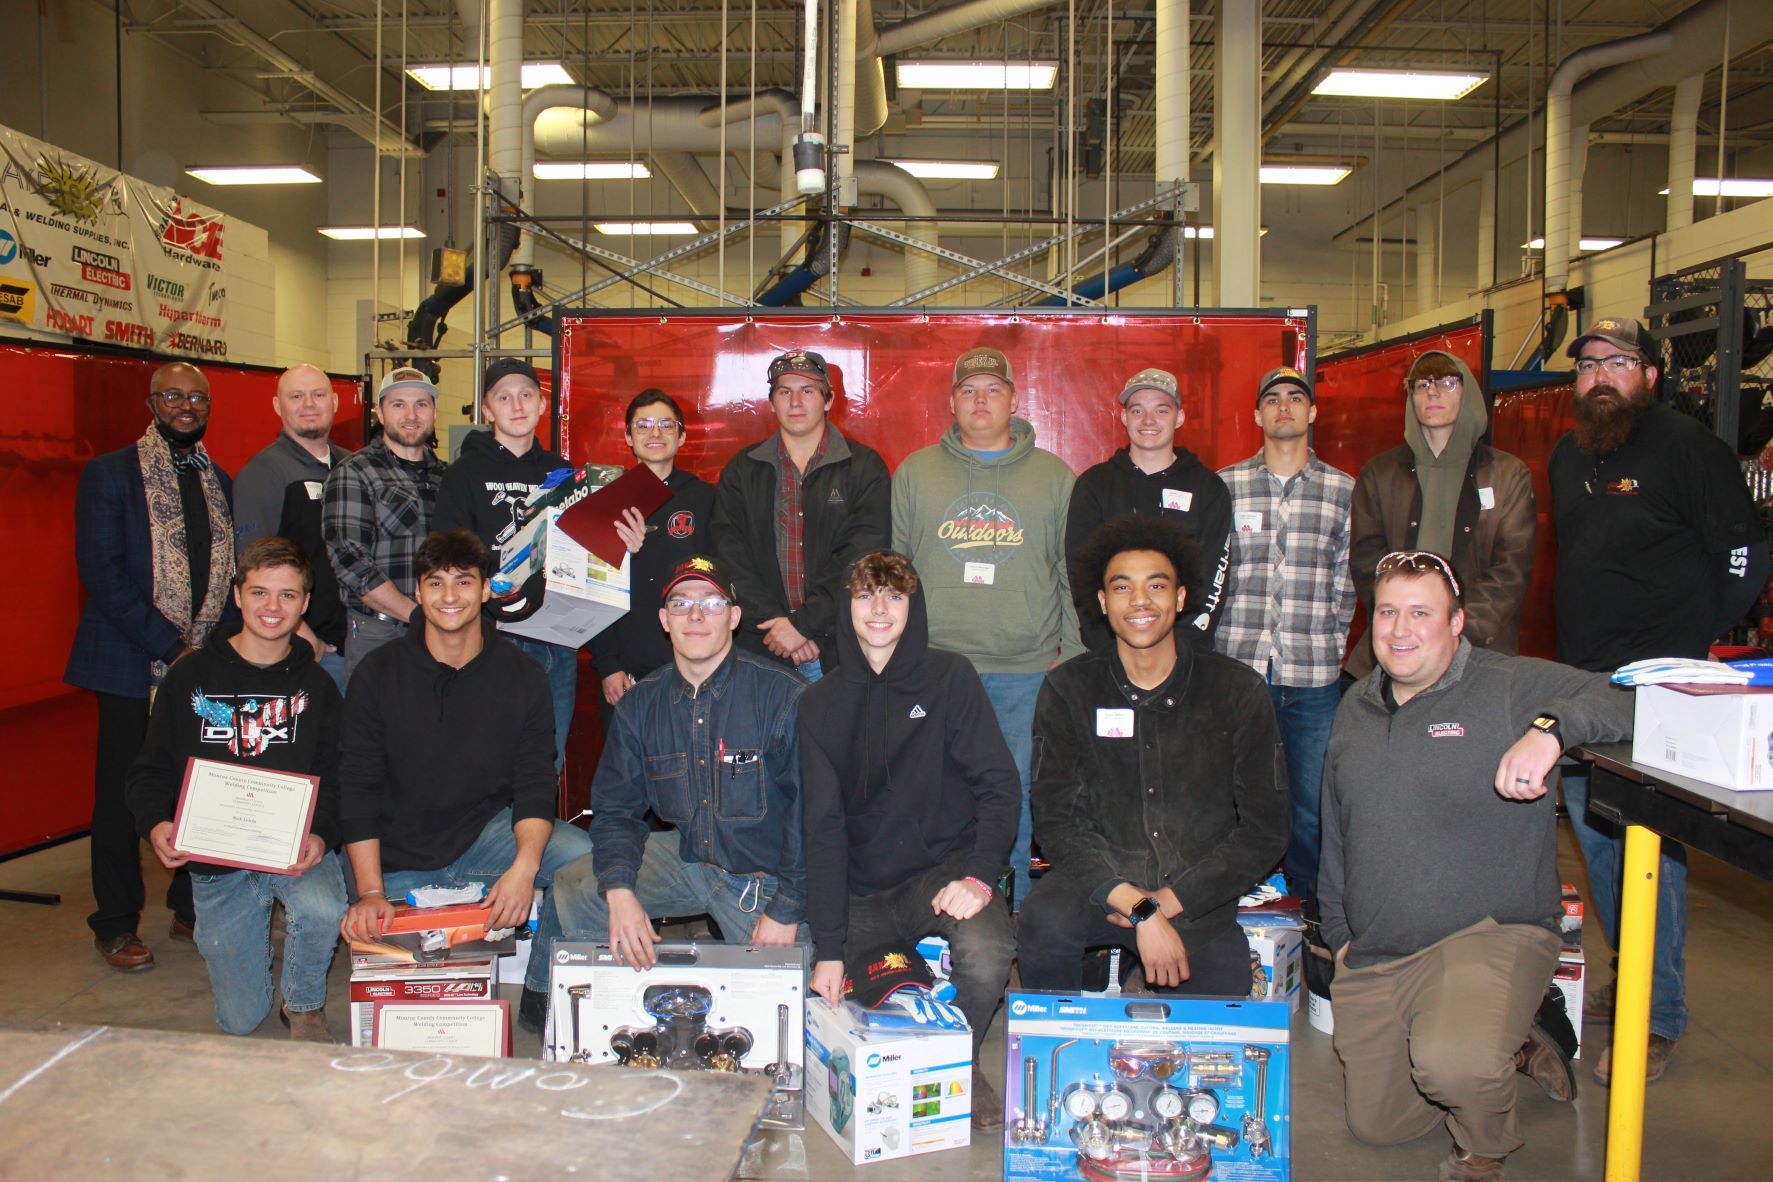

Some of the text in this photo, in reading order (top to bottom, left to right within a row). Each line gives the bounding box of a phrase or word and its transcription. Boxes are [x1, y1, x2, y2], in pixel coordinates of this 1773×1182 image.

[26, 211, 70, 231] WELDING
[73, 225, 111, 245] SUPPLIES,
[74, 247, 119, 271] LINCOLN
[163, 246, 221, 271] Hardware
[87, 266, 126, 287] ELECTRIC
[147, 273, 185, 297] VICTOR
[50, 283, 133, 311] THERMAL DYNAMICS
[104, 319, 155, 347] SMITH
[555, 485, 589, 511] etabo
[937, 520, 1025, 547] Outdoors
[1729, 546, 1749, 578] EST
[1430, 723, 1458, 732] LINCOLN
[569, 953, 588, 961] Miller
[404, 985, 441, 994] 3350
[1027, 1004, 1088, 1014] Miller SMITH
[882, 1054, 902, 1063] Miller
